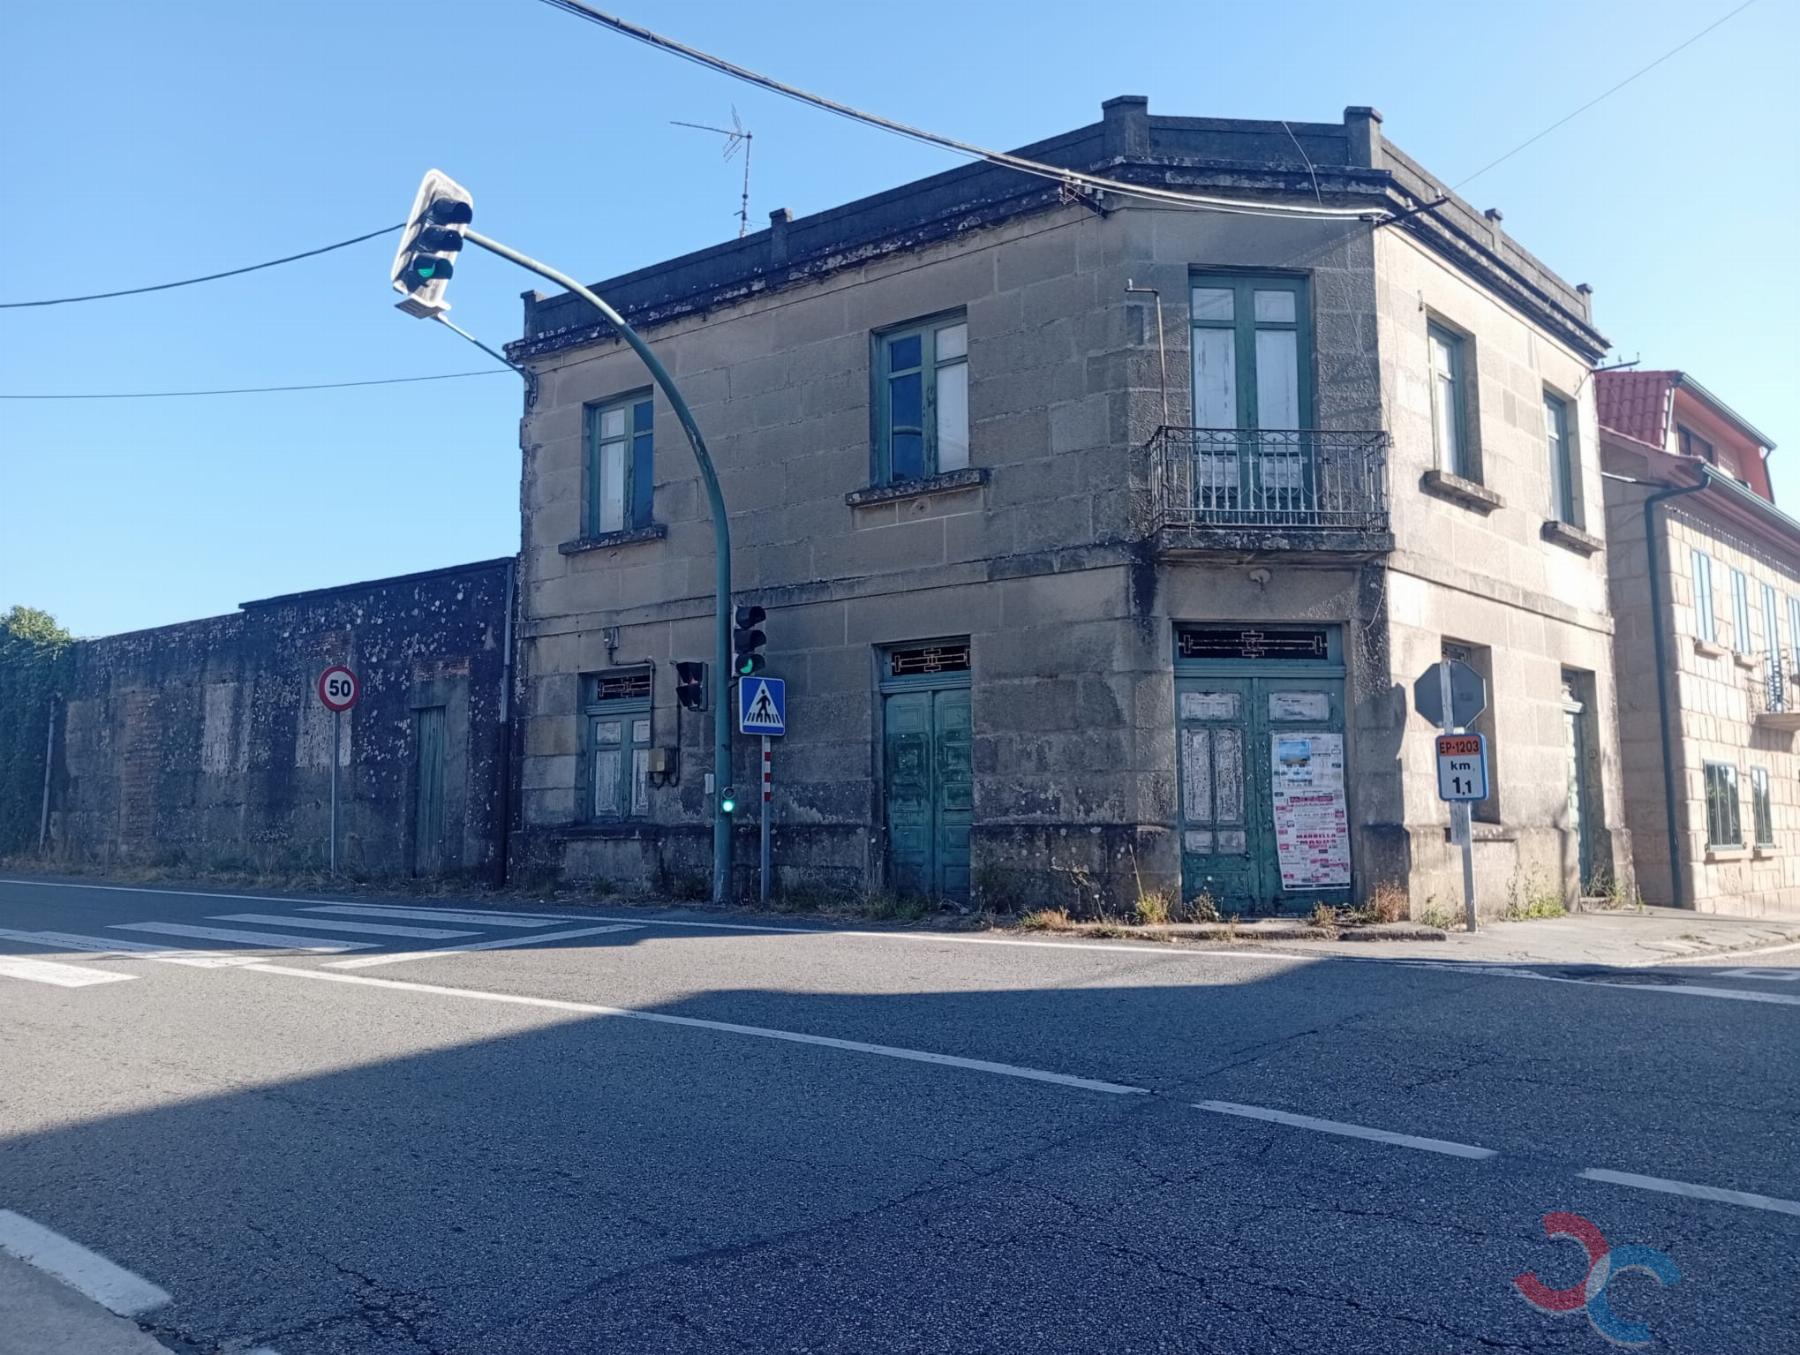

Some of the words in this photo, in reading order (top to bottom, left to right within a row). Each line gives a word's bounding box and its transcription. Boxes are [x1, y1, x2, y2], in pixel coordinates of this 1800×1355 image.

[329, 679, 352, 697] 50
[1440, 740, 1480, 754] EP-1203
[1450, 760, 1471, 771] km
[1452, 776, 1472, 796] 1.1
